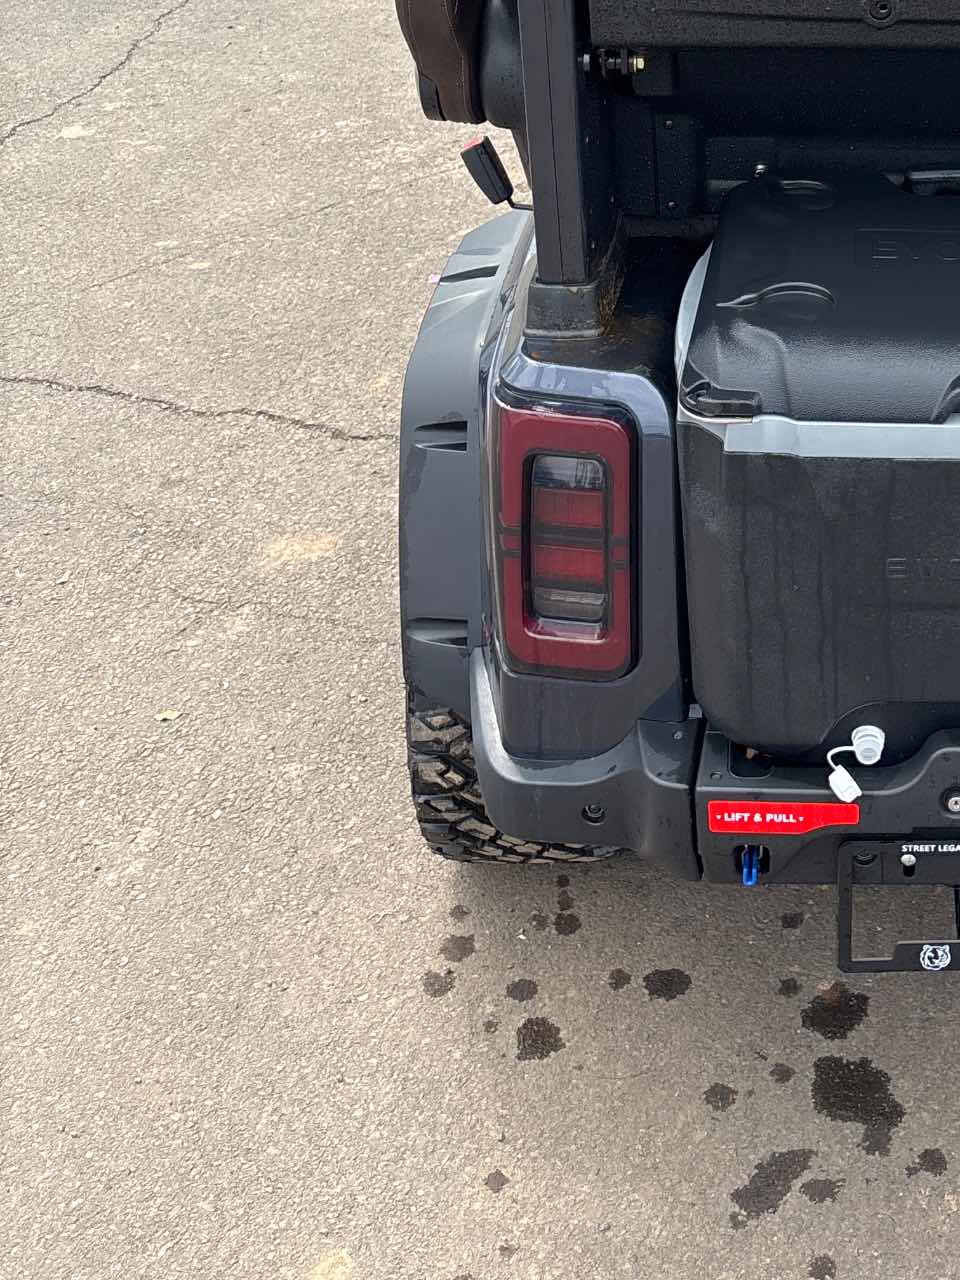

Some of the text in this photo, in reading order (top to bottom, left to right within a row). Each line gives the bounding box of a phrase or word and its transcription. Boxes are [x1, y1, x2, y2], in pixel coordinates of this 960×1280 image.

[724, 812, 797, 823] LIFT & PULL
[901, 844, 936, 852] STREET
